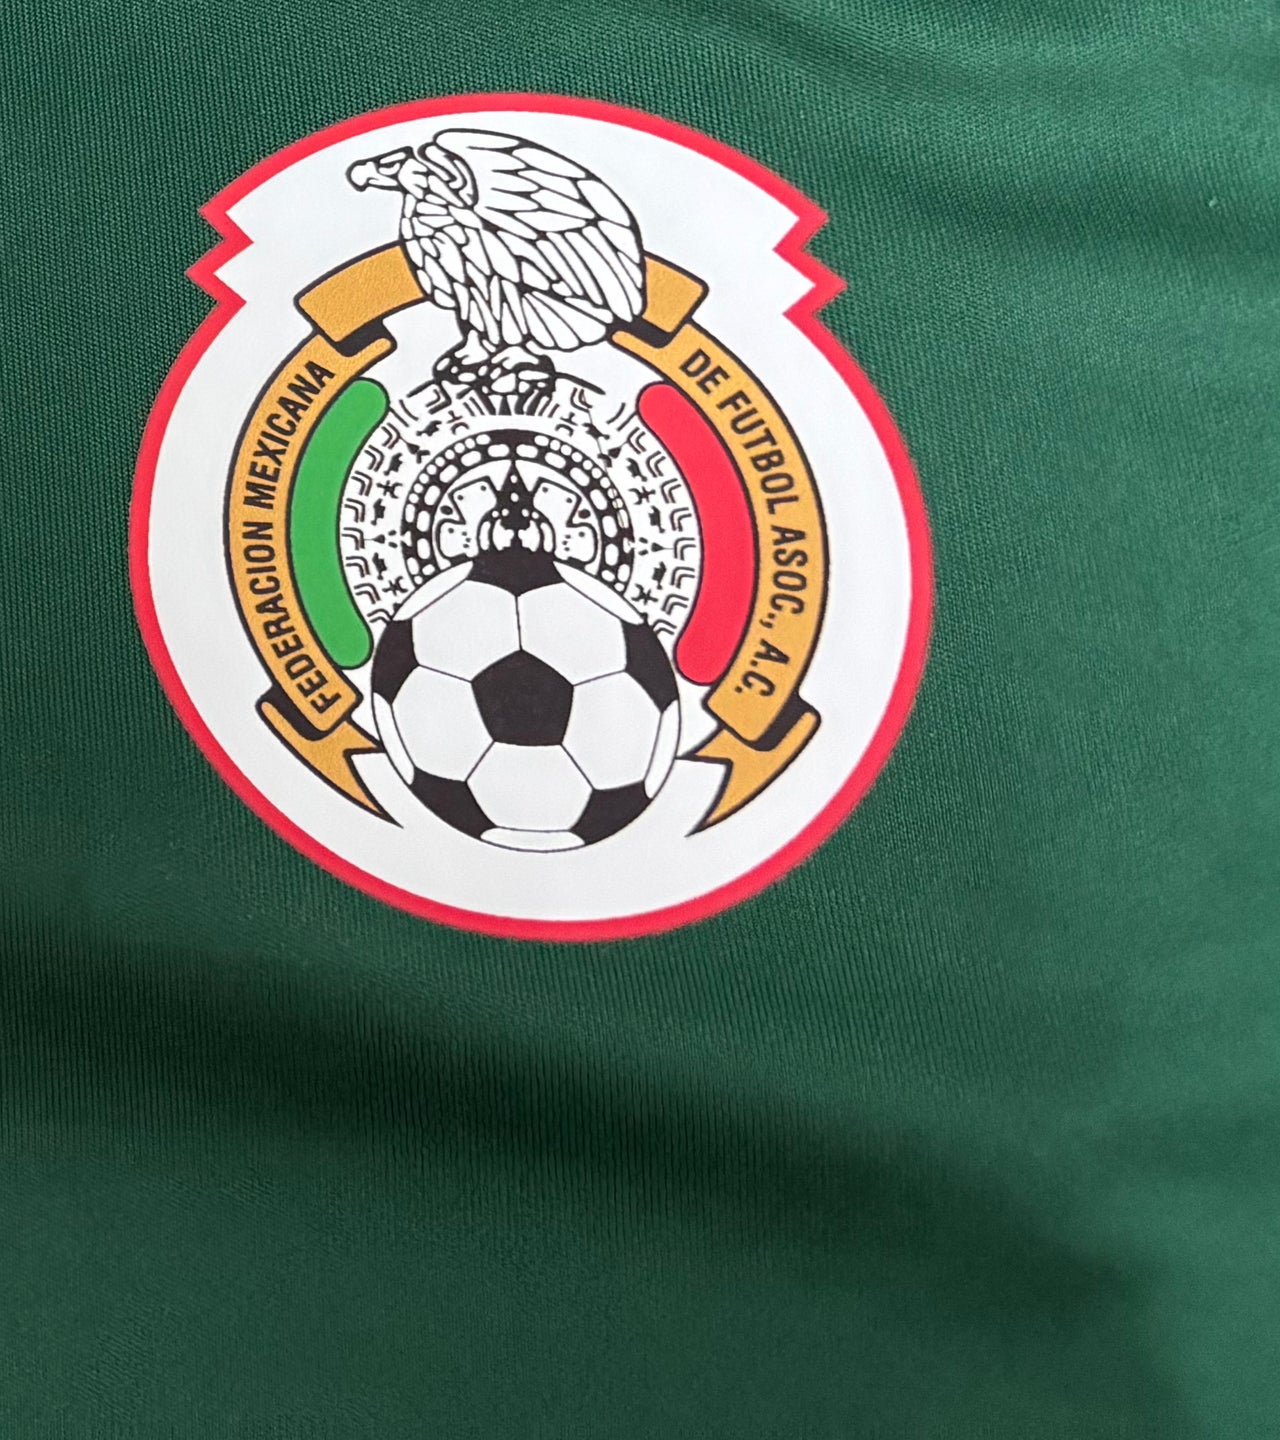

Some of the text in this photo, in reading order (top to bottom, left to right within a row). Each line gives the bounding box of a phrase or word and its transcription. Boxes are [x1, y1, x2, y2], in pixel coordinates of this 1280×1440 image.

[679, 348, 731, 395] DE
[716, 390, 800, 515] FUTBOL
[242, 360, 342, 714] FEDERACION MEXICANA
[734, 638, 790, 698] A.C.
